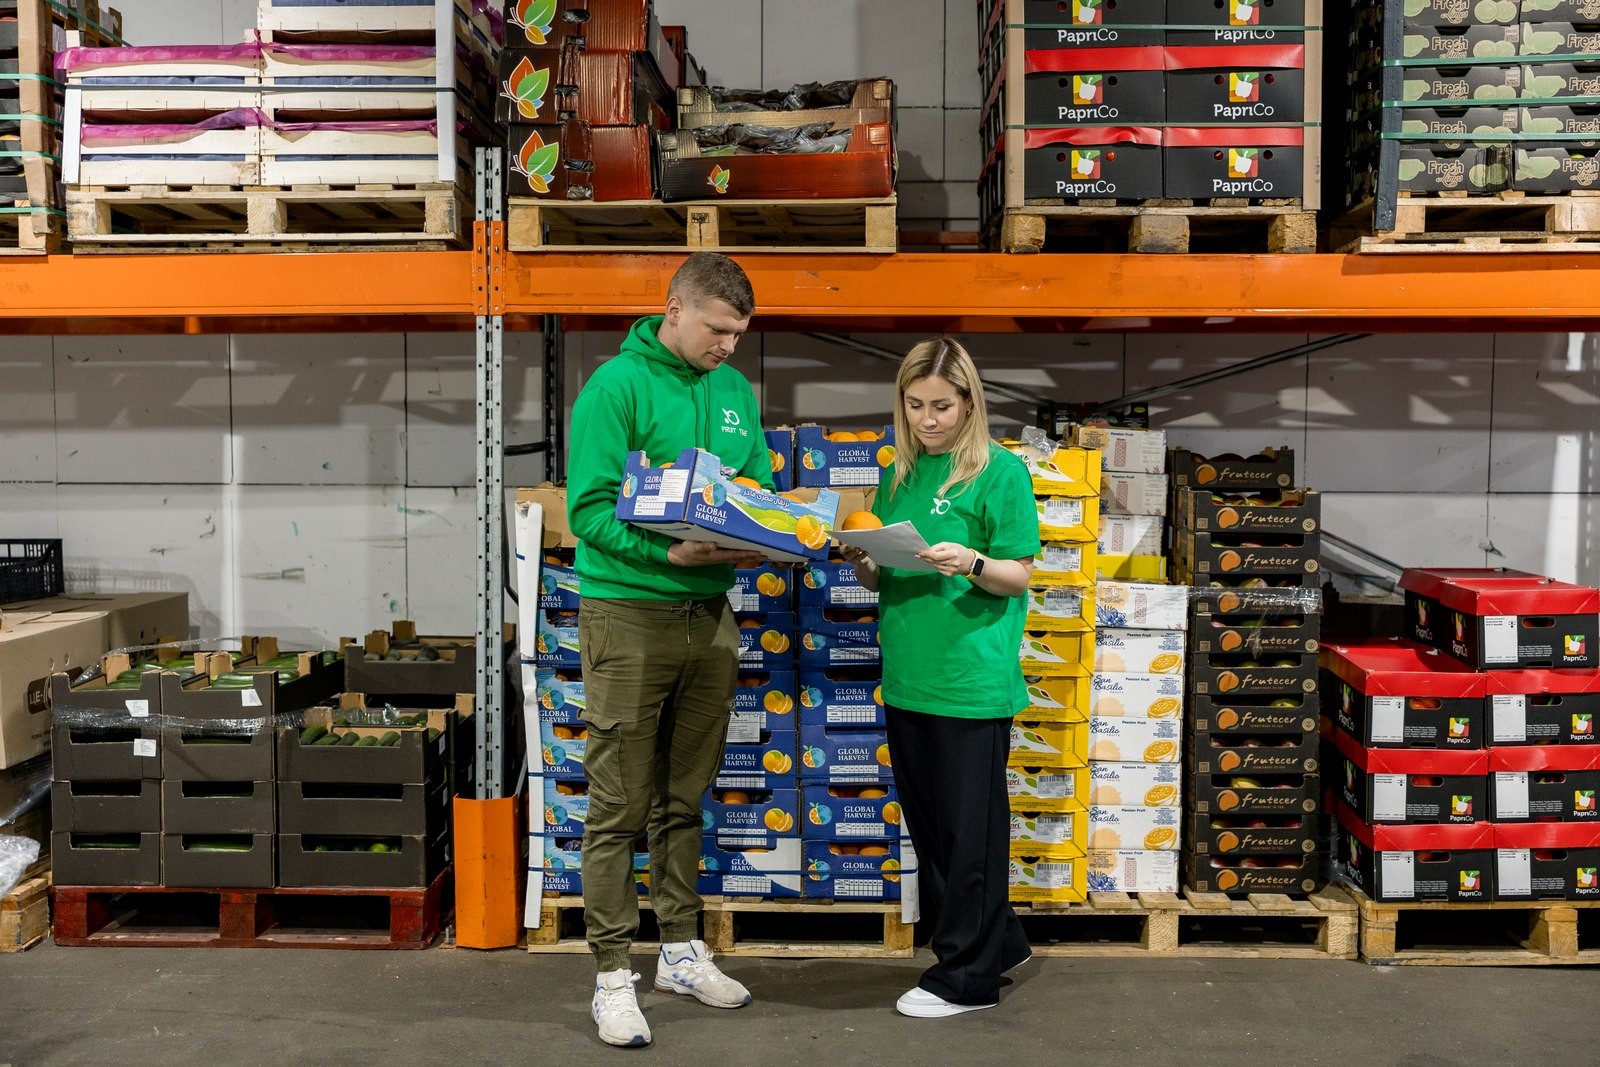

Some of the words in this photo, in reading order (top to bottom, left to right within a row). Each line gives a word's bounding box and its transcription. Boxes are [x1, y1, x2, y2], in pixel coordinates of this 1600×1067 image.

[1569, 0, 1600, 9] Fres
[1057, 28, 1118, 44] PapriCo
[1215, 29, 1275, 43] PapriCo
[1432, 36, 1468, 51] Fresh
[1433, 80, 1469, 95] Fresh
[1058, 105, 1118, 122] PapriCo
[1213, 103, 1274, 120] PapriCo
[1428, 159, 1464, 174] Fresh
[1563, 158, 1599, 172] Fresh
[1056, 180, 1116, 196] PapriCo
[1213, 179, 1273, 195] PapriCo
[721, 426, 736, 434] FRUIT
[1219, 467, 1272, 480] frutecer
[696, 503, 727, 519] GLOBAL
[695, 512, 726, 526] HARVEST
[1241, 511, 1297, 526] frutecer
[1243, 553, 1299, 568] frutecer
[735, 576, 750, 584] BAL
[1096, 630, 1113, 639] San
[1096, 638, 1124, 647] Basilio
[1093, 674, 1111, 683] San
[1241, 674, 1297, 688] frutecer
[1093, 682, 1123, 691] Basilio
[1090, 718, 1108, 726] San
[1240, 711, 1297, 726] frutecer
[1090, 725, 1119, 734] Basilio
[1090, 763, 1108, 772] San
[1242, 753, 1299, 768] frutecer
[1090, 771, 1120, 779] Basilio
[1241, 793, 1297, 807] frutecer
[1090, 807, 1108, 815] San
[1090, 814, 1119, 822] Basilio
[1240, 835, 1296, 849] frutecer
[1240, 873, 1296, 887] frutecer
